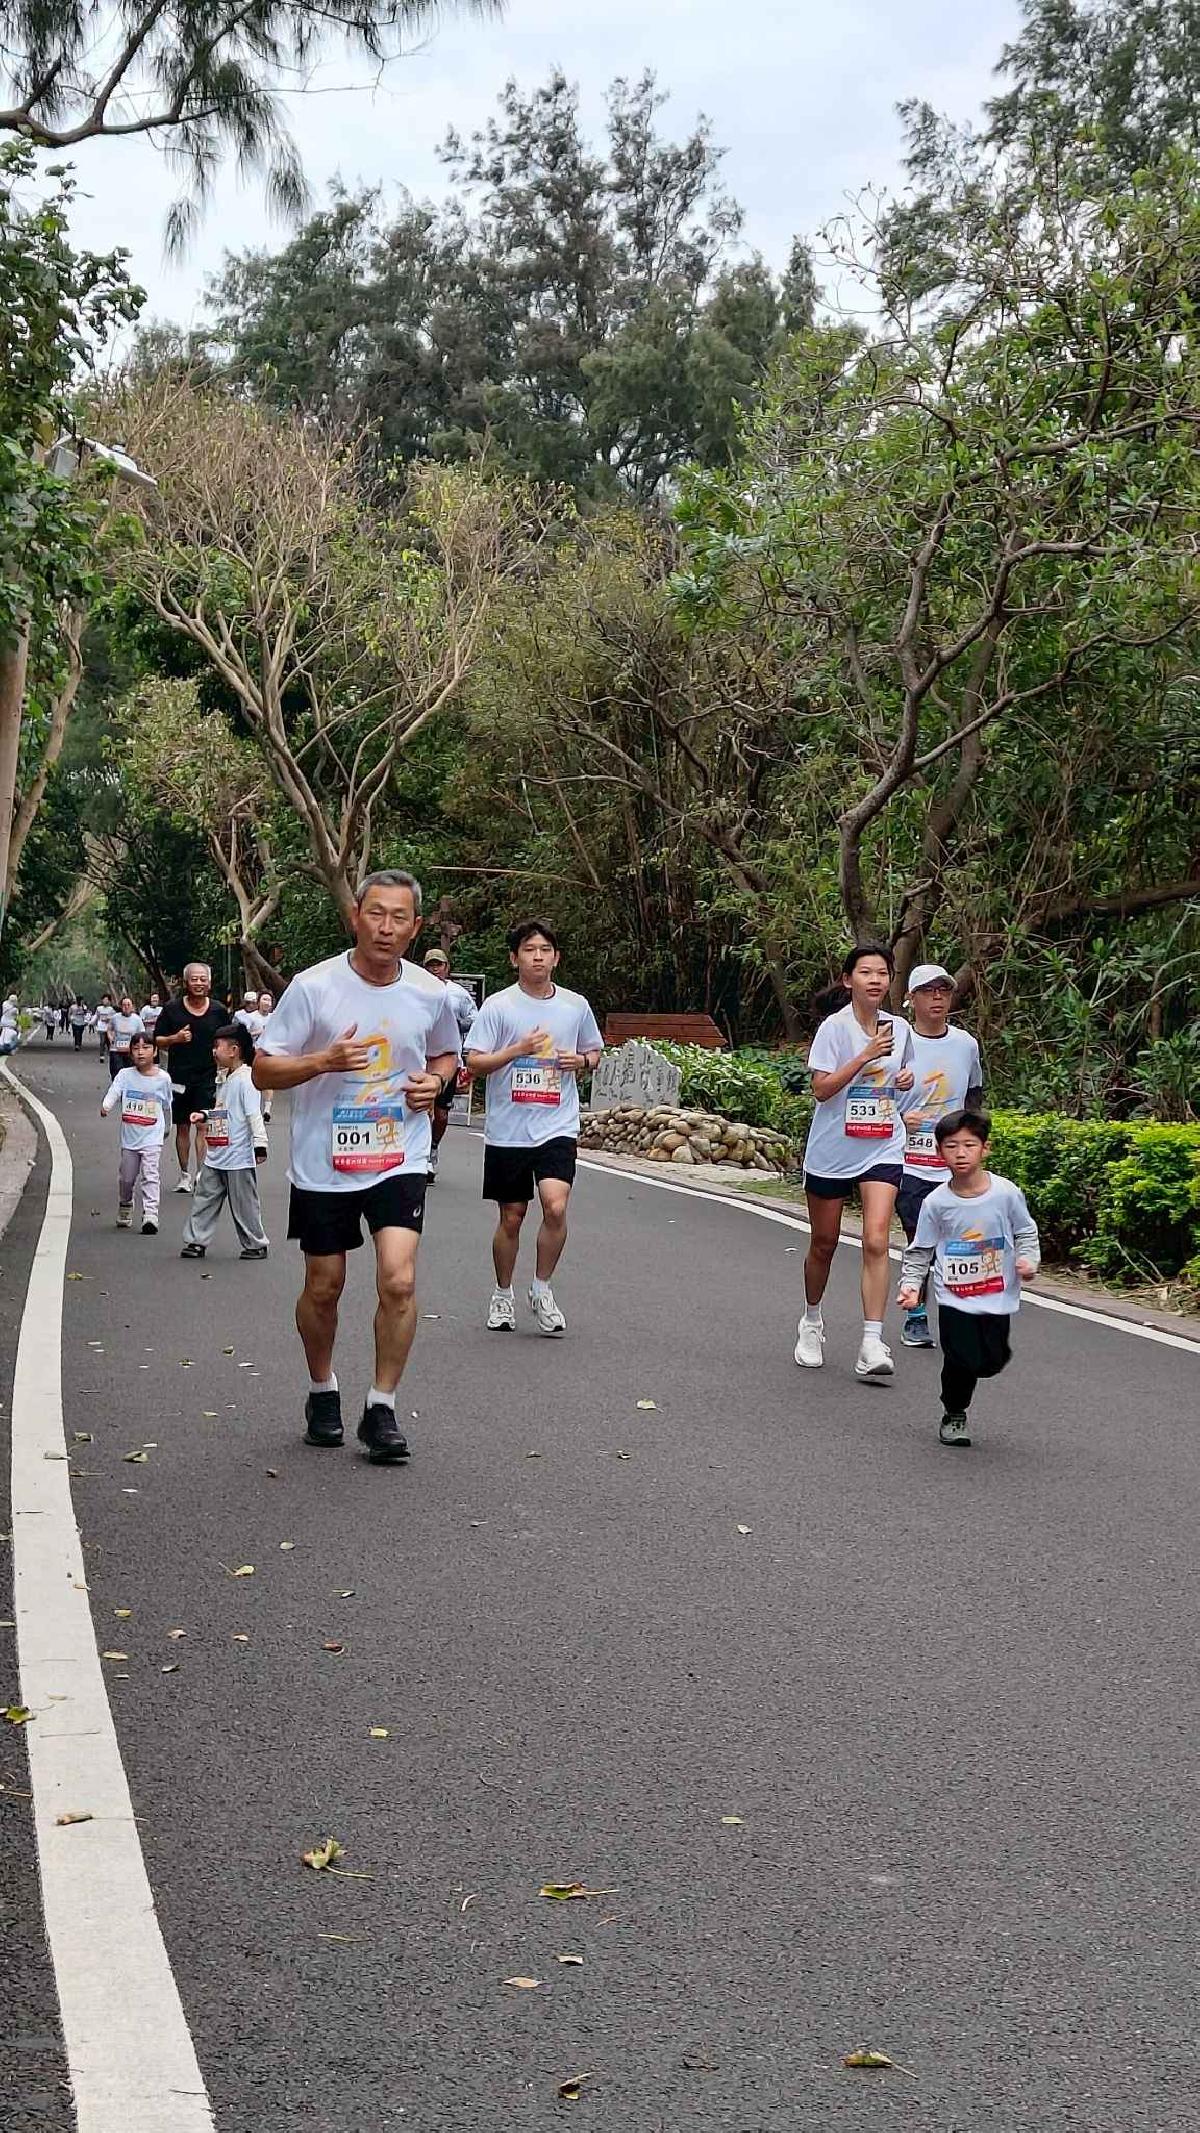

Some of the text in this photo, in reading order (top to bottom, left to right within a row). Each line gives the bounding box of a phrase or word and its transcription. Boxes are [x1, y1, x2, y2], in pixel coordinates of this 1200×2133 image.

[850, 1105, 876, 1116] 533
[337, 1131, 370, 1145] 001
[909, 1136, 933, 1148] 548
[947, 1262, 979, 1275] 105
